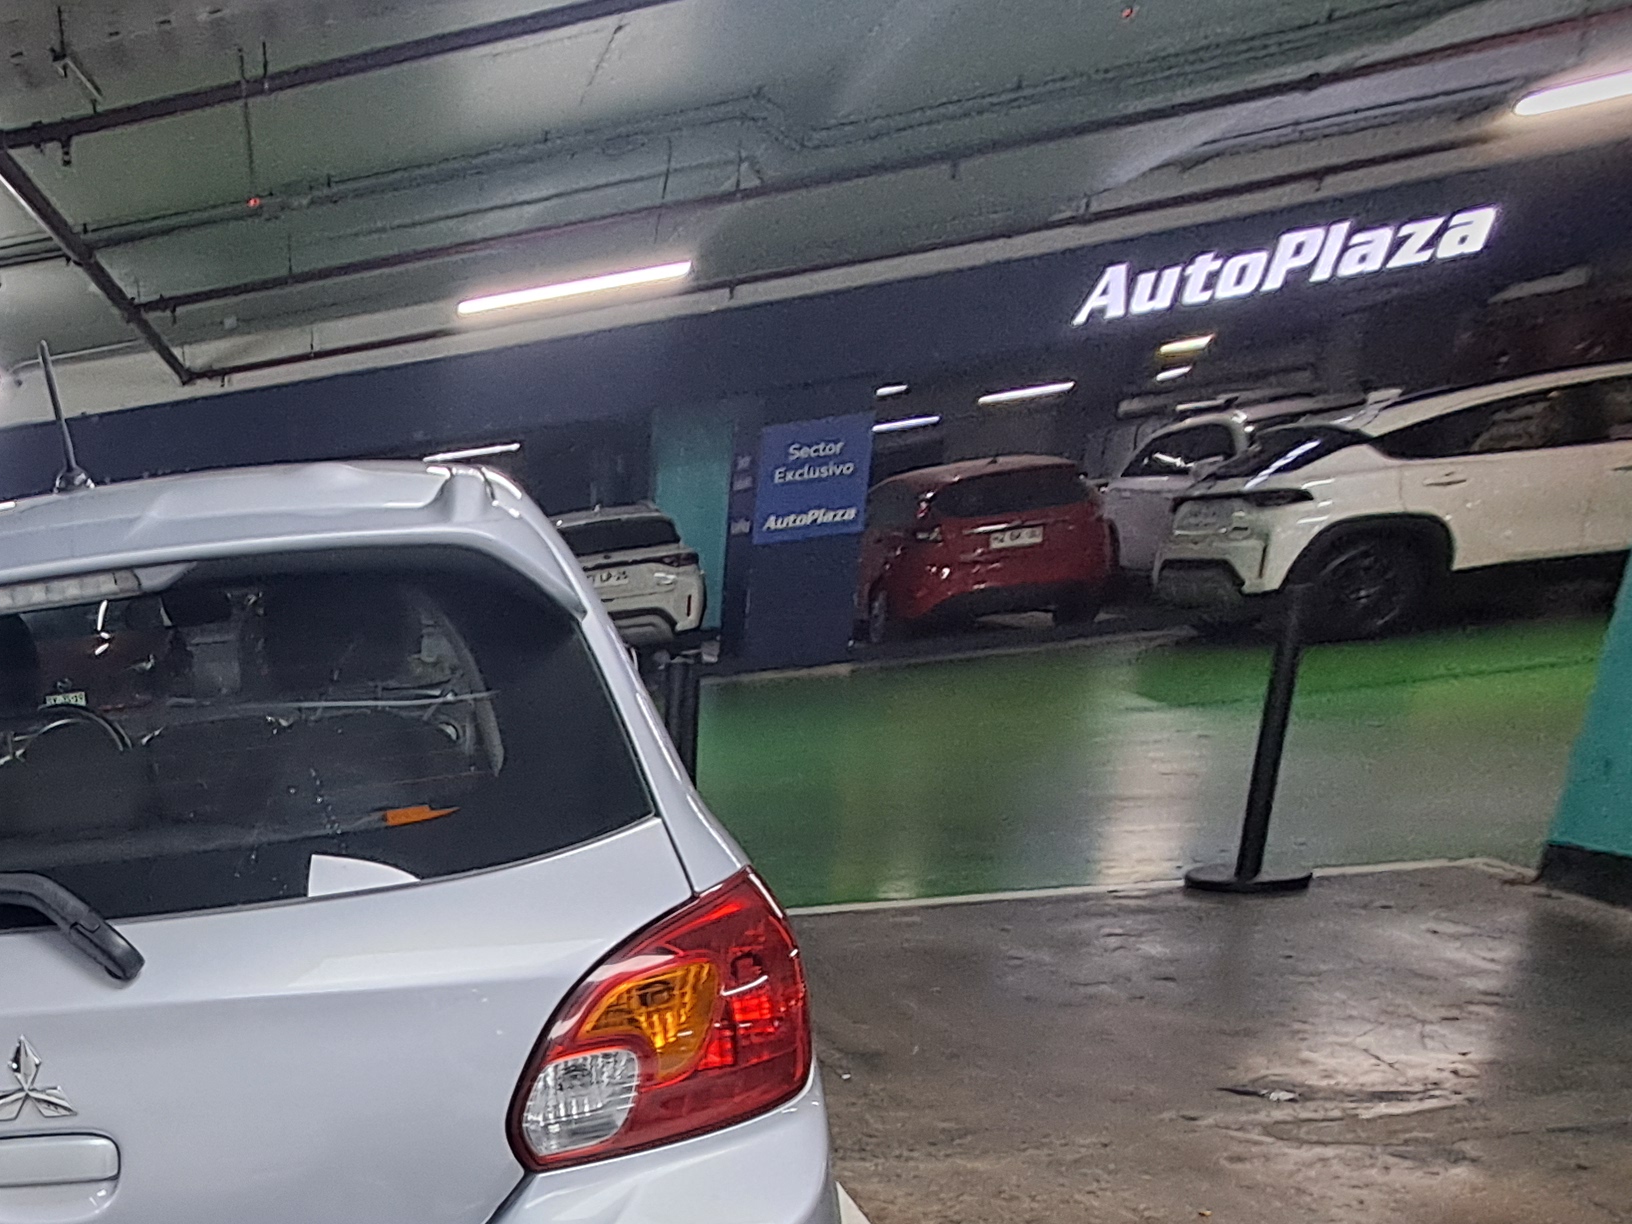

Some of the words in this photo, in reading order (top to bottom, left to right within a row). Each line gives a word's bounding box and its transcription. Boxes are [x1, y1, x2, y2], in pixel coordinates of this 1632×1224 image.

[1070, 204, 1499, 327] AutoPlaza
[788, 441, 845, 461] Sector
[774, 462, 855, 483] Exclusivo
[762, 507, 858, 531] AutoPlaza
